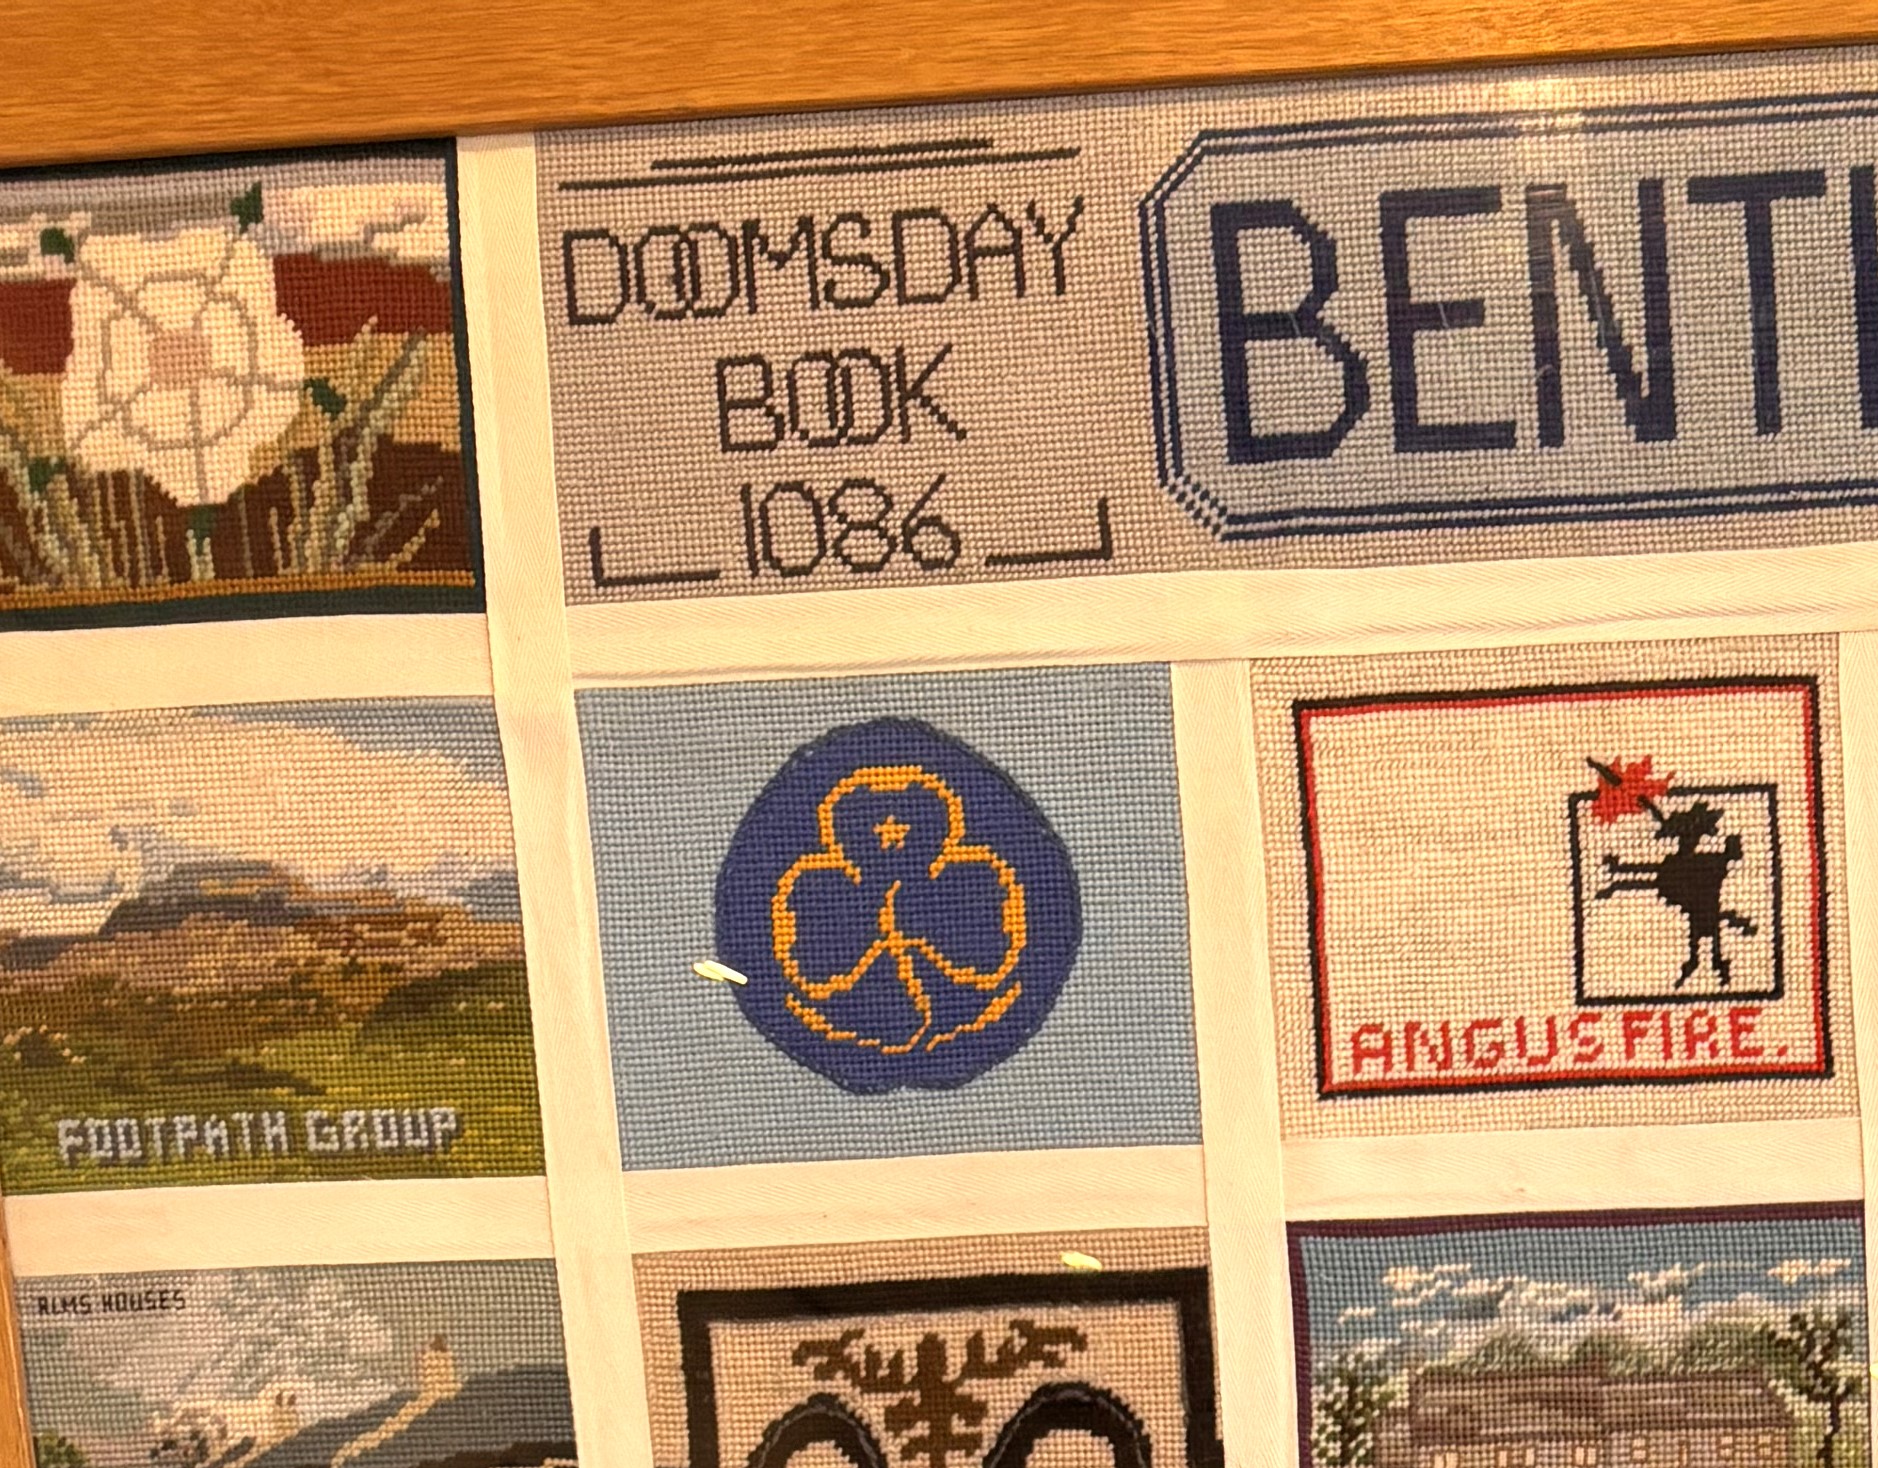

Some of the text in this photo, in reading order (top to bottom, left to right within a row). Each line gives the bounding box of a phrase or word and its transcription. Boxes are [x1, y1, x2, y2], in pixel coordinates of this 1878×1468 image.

[563, 197, 1084, 325] DOOMSDAY
[716, 344, 967, 453] BOOK
[741, 474, 961, 577] 1086
[1350, 1012, 1601, 1074] ANGUS
[56, 1107, 458, 1166] FOOTPATH GROUP
[38, 1289, 186, 1315] ALMS HOUSES
